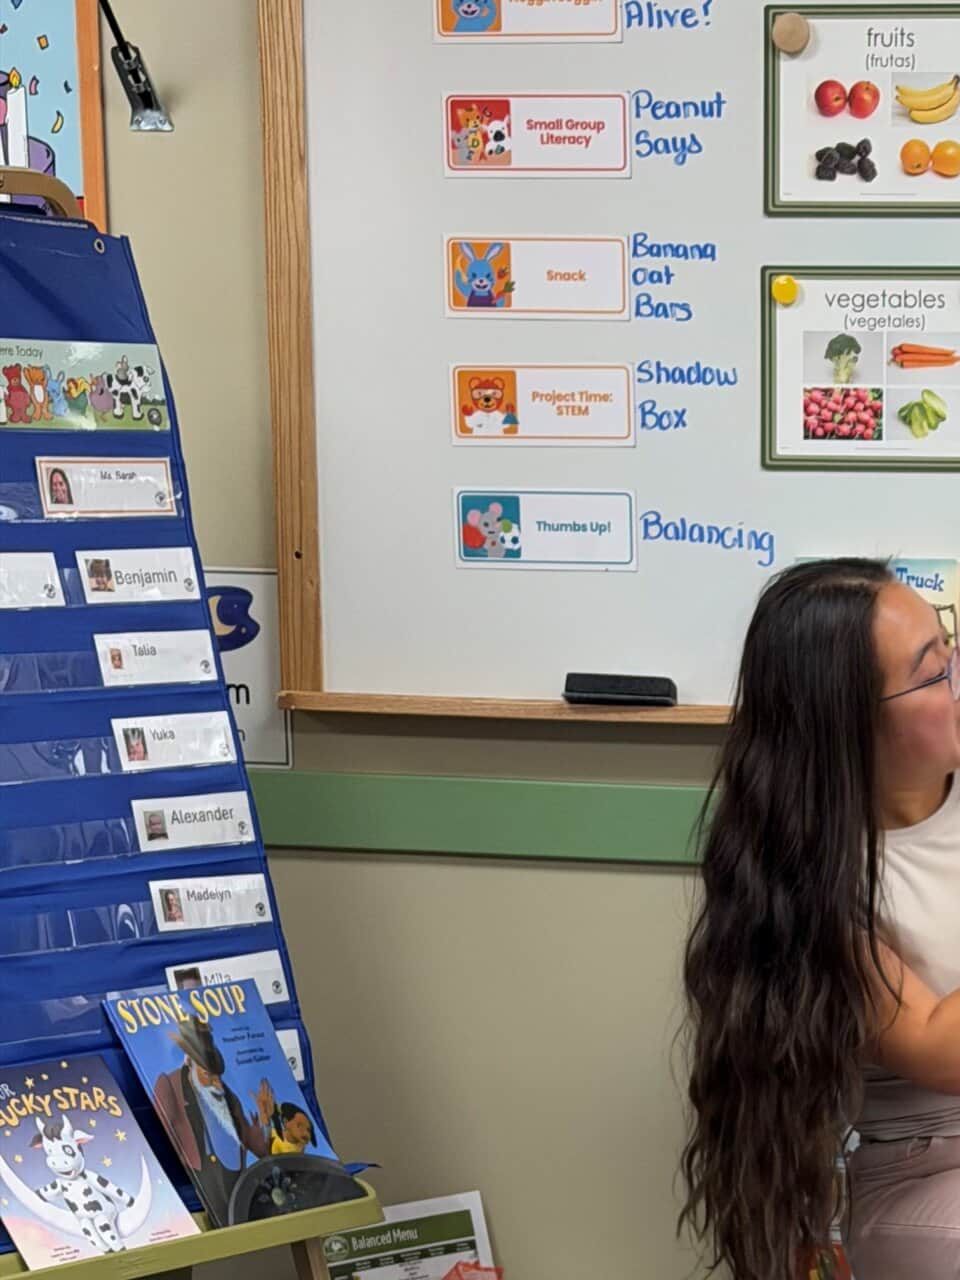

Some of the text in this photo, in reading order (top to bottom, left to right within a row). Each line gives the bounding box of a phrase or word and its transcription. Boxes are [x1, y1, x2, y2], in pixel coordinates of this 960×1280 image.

[866, 27, 915, 48] fruits
[865, 53, 916, 71] (frutas)
[632, 90, 727, 119] Peanut
[526, 119, 605, 134] Small Group
[540, 133, 592, 148] Literacy
[634, 130, 703, 166] Says
[632, 232, 717, 261] Banana
[546, 269, 586, 282] Snack
[635, 292, 693, 321] Bars
[825, 289, 946, 312] vegetables
[843, 315, 926, 332] (vegetales)
[15, 345, 43, 360] Today
[636, 360, 738, 386] Shadow
[531, 391, 613, 406] Project Time:
[556, 404, 589, 416] STEM
[639, 399, 687, 431] Box
[536, 520, 612, 536] Thumbs Up!
[639, 511, 775, 566] Balancing
[114, 567, 178, 586] Benjamin
[895, 567, 945, 593] Truck
[132, 644, 157, 657] Talia
[149, 728, 175, 741] Yuka
[170, 807, 234, 825] Alexander
[117, 985, 247, 1034] STONE SOUP
[52, 1086, 123, 1117] STARS
[351, 1228, 418, 1251] Balanced Menu
